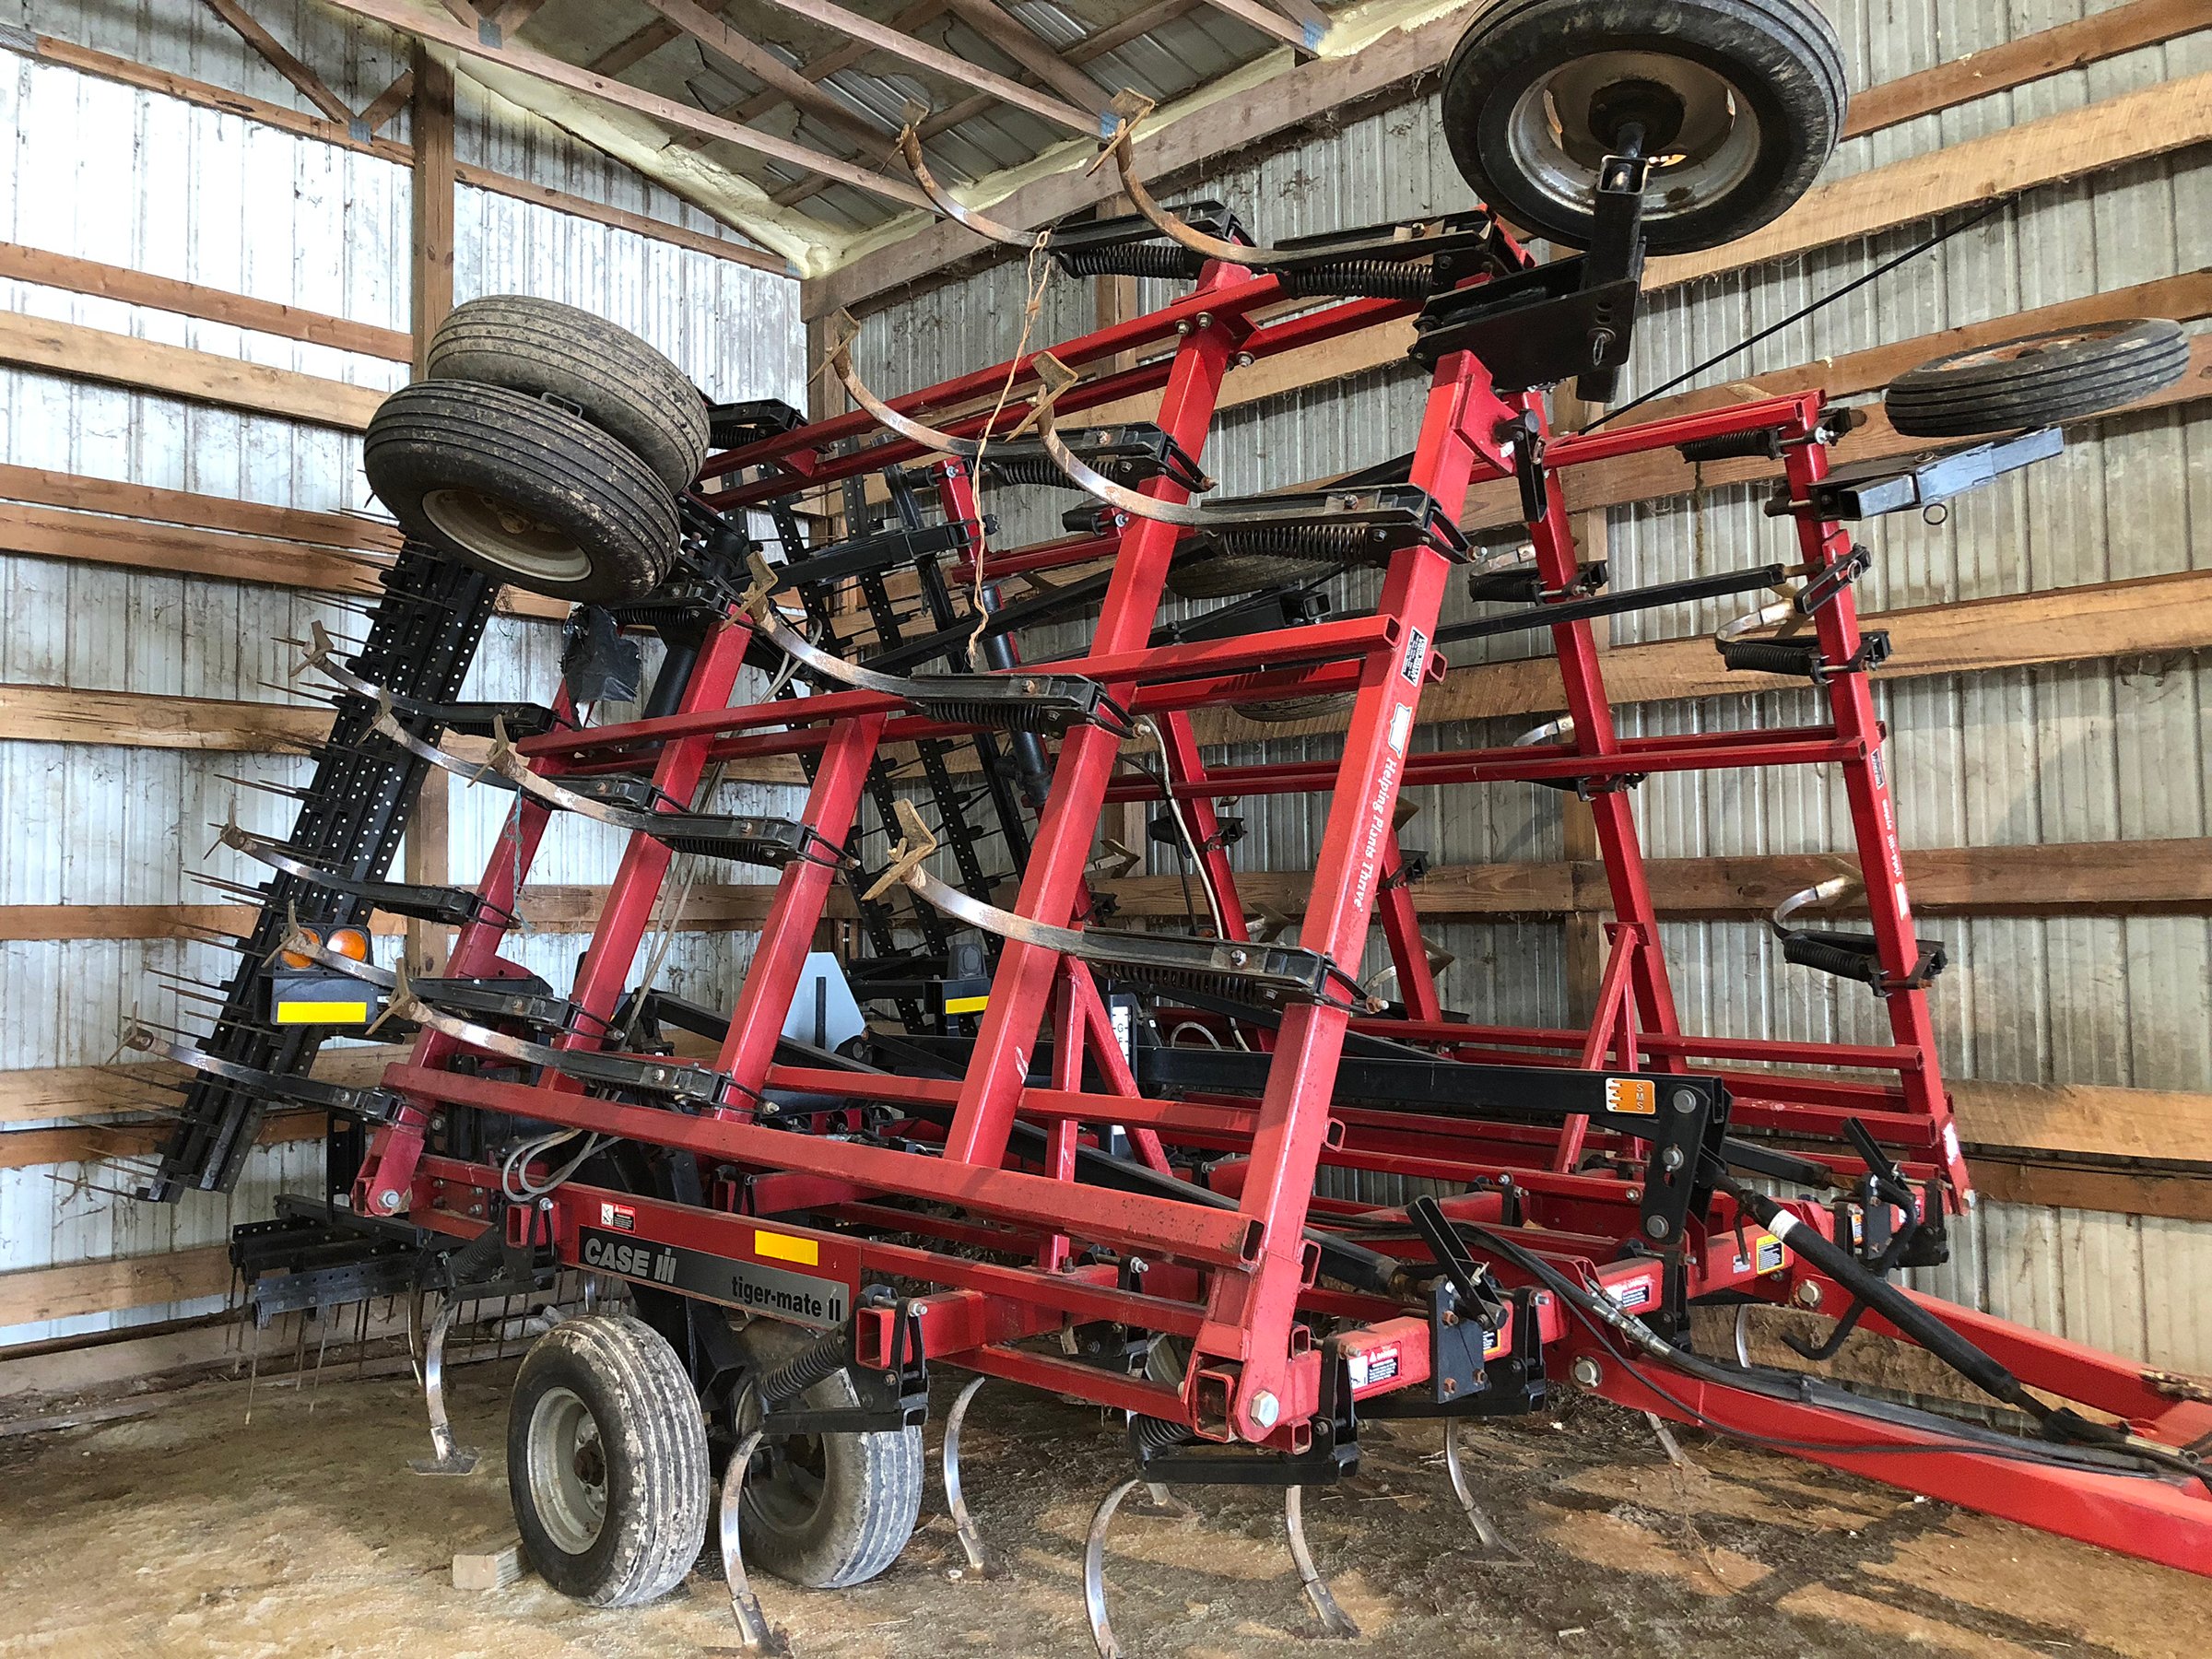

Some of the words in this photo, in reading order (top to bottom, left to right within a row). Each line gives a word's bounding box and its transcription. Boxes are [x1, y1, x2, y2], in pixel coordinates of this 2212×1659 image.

[1371, 757, 1397, 815] Helping
[1365, 814, 1385, 858] Plants
[1117, 1023, 1124, 1032] G
[584, 1238, 651, 1277] CASE
[731, 1276, 822, 1317] tiger-mate
[828, 1298, 841, 1322] II
